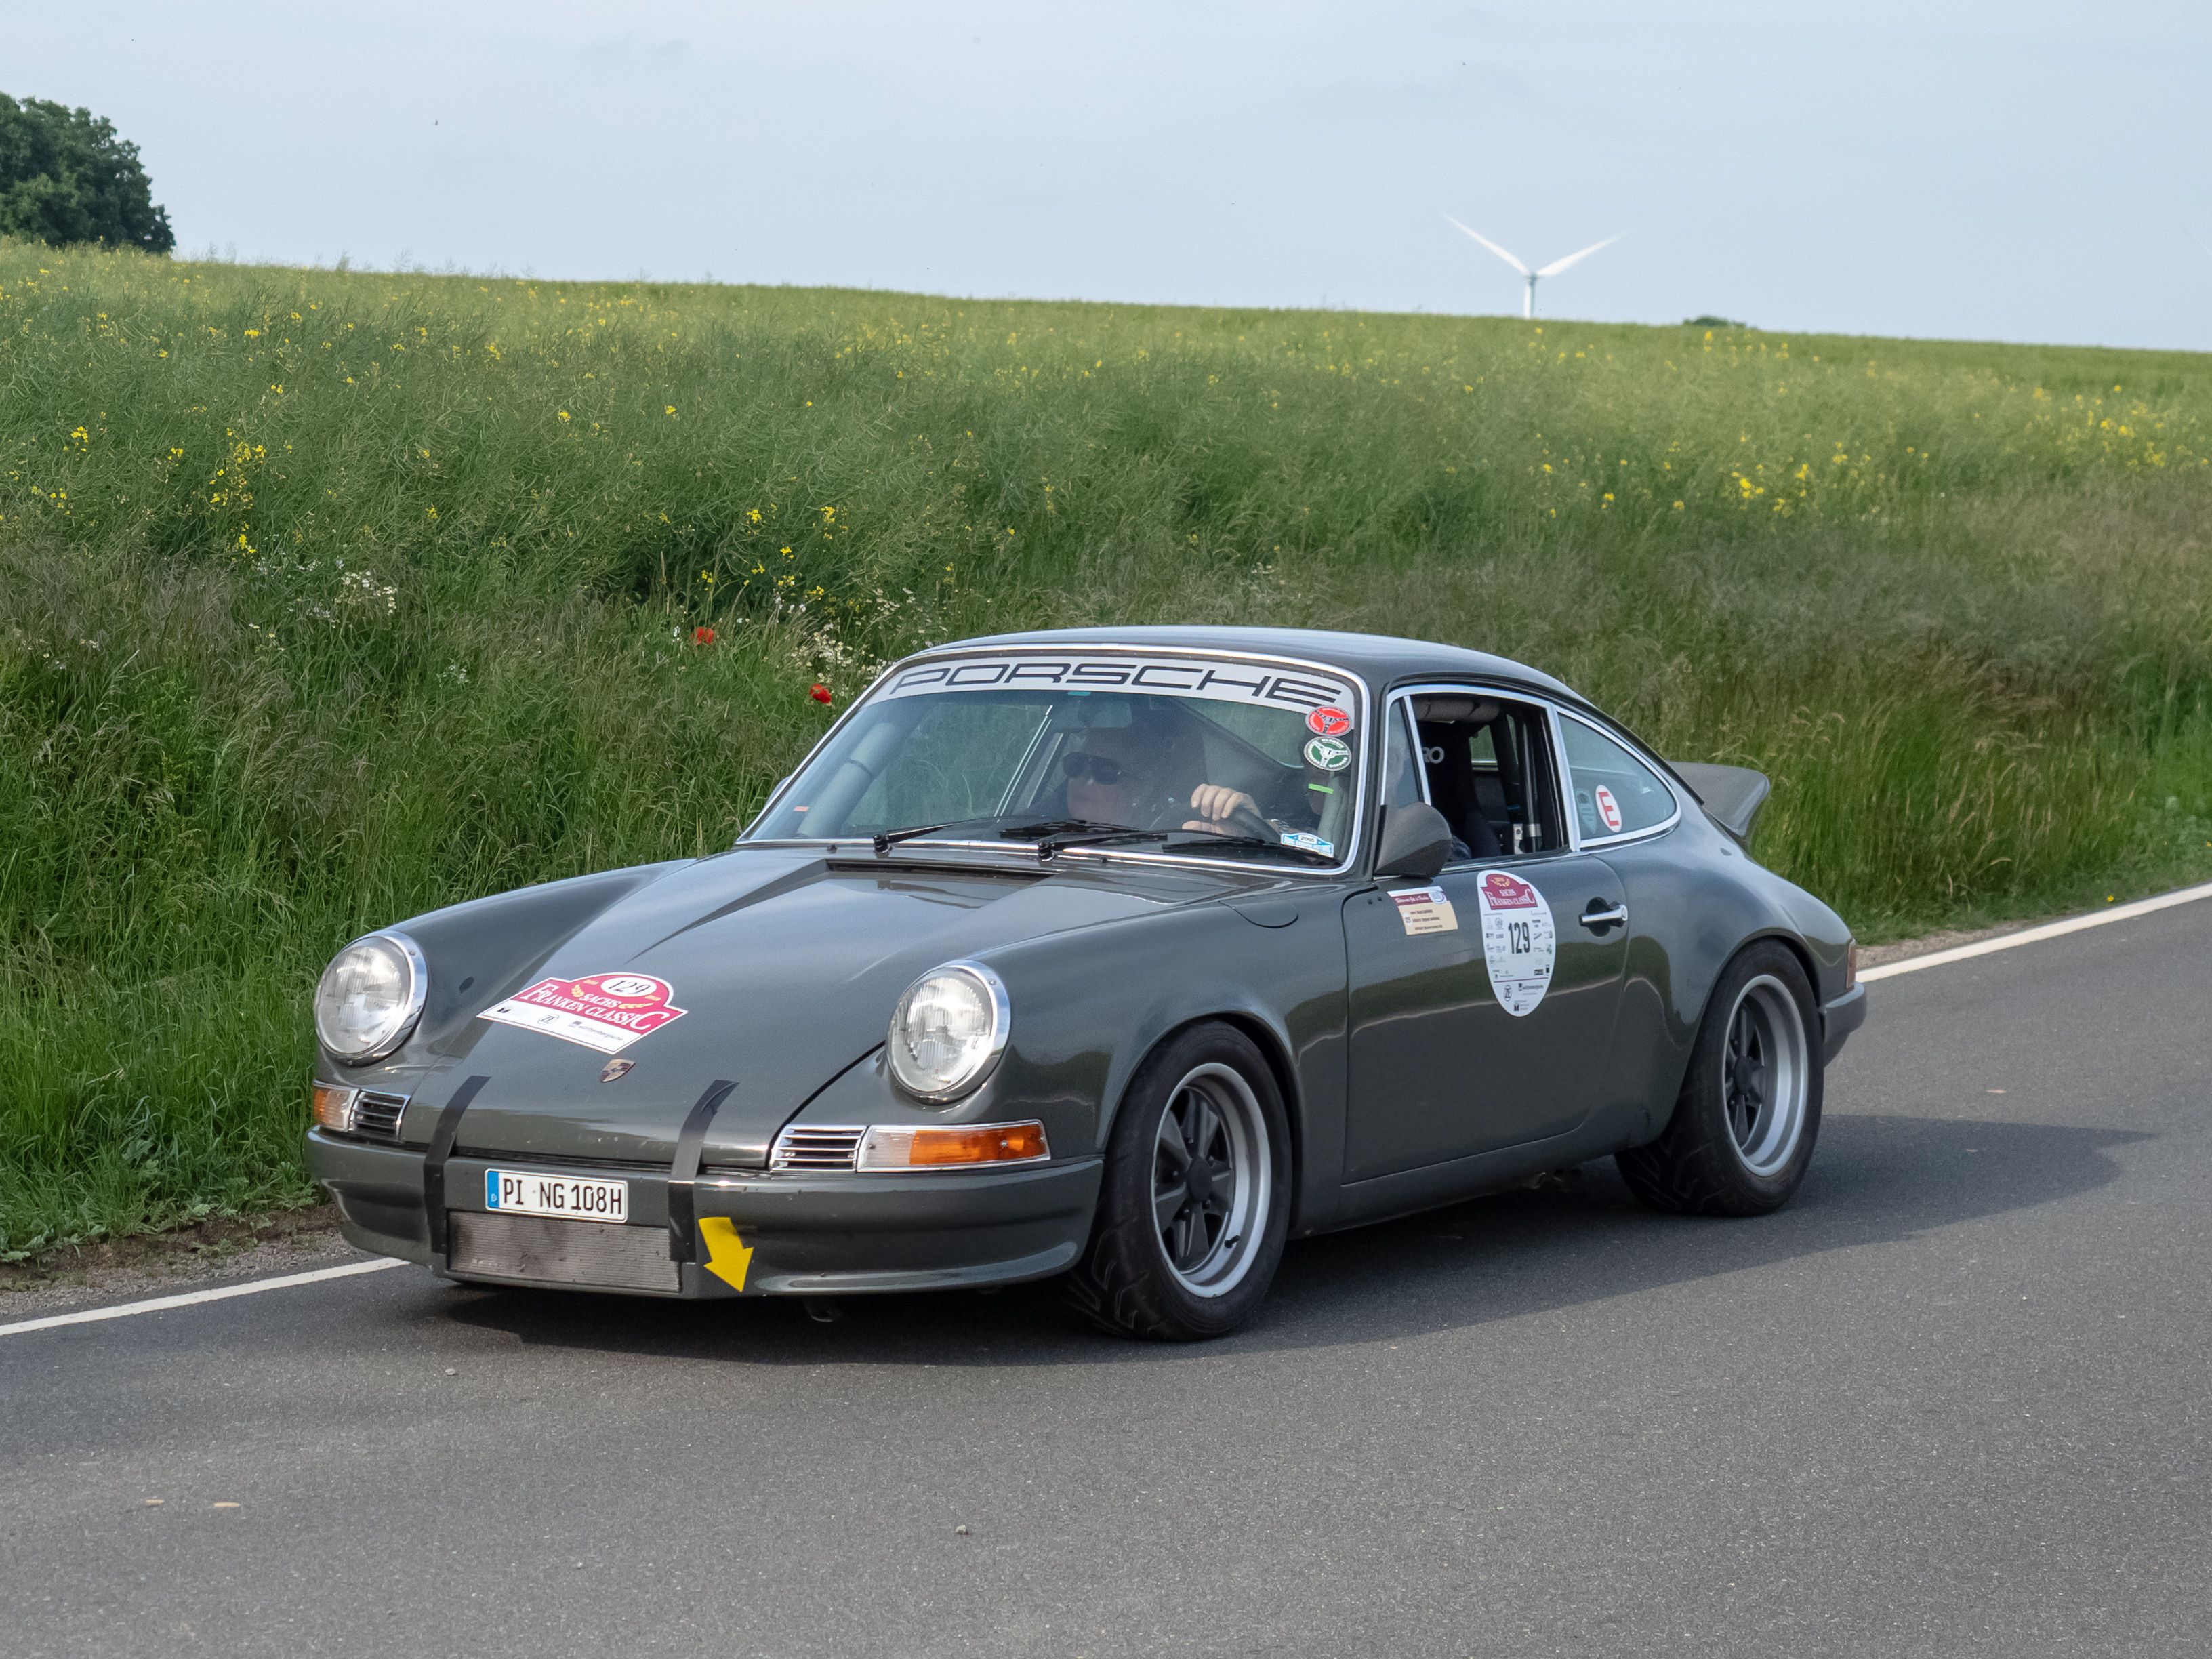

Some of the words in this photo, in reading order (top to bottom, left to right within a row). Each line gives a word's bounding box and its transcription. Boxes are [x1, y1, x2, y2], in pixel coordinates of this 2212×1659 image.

[889, 662, 1343, 707] PORSCHE
[1597, 791, 1620, 826] E
[1485, 891, 1513, 906] FRANKEN
[1513, 888, 1536, 905] CLASSIC
[1499, 888, 1517, 897] SACHS
[1508, 922, 1531, 954] 129
[579, 994, 622, 1008] SACHS
[607, 979, 651, 995] 129
[520, 983, 591, 1012] FRANKEN
[584, 1006, 671, 1031] CLASSIC
[503, 1177, 525, 1206] PI
[539, 1181, 565, 1210] NG
[571, 1183, 622, 1215] 108H
